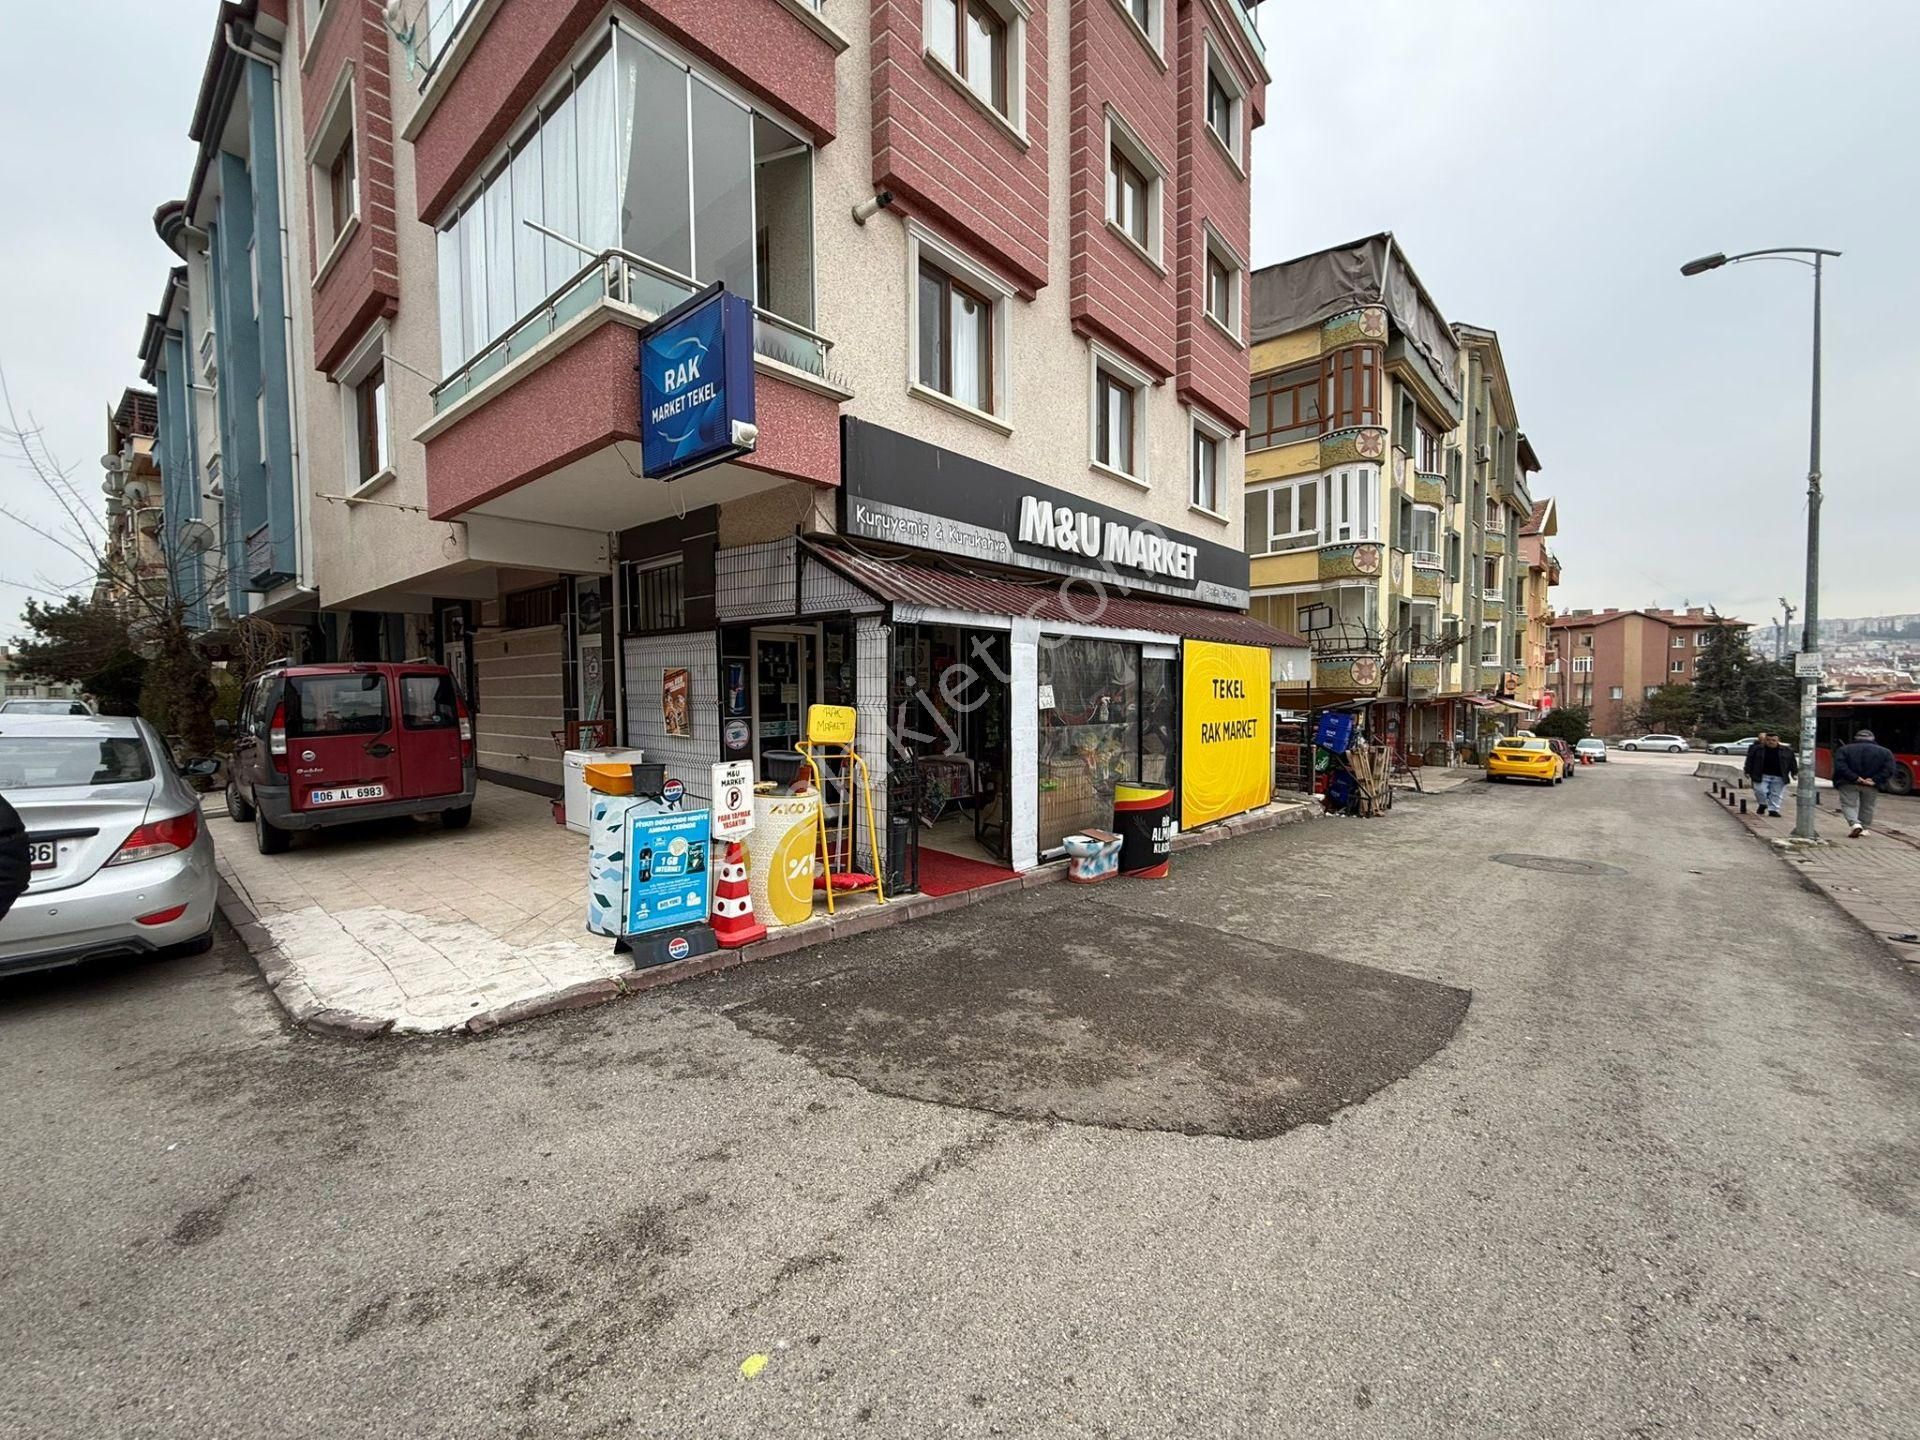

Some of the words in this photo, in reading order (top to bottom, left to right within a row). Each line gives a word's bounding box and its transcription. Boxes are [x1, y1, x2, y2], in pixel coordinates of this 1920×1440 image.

[664, 354, 701, 393] RAK
[652, 394, 687, 425] MARKET
[687, 382, 716, 408] TEKEL
[856, 504, 929, 540] Kuruyemiş
[934, 522, 944, 540] &
[949, 525, 1007, 553] Kurukahve
[1018, 495, 1101, 558] M&U
[1102, 521, 1198, 580] MARKET
[1212, 678, 1246, 699] TEKEL
[1201, 722, 1222, 744] RAK
[1222, 718, 1258, 741] MARKET
[320, 791, 333, 802] 06
[340, 789, 352, 800] AL
[357, 786, 382, 798] 6983
[721, 777, 745, 787] MARKET
